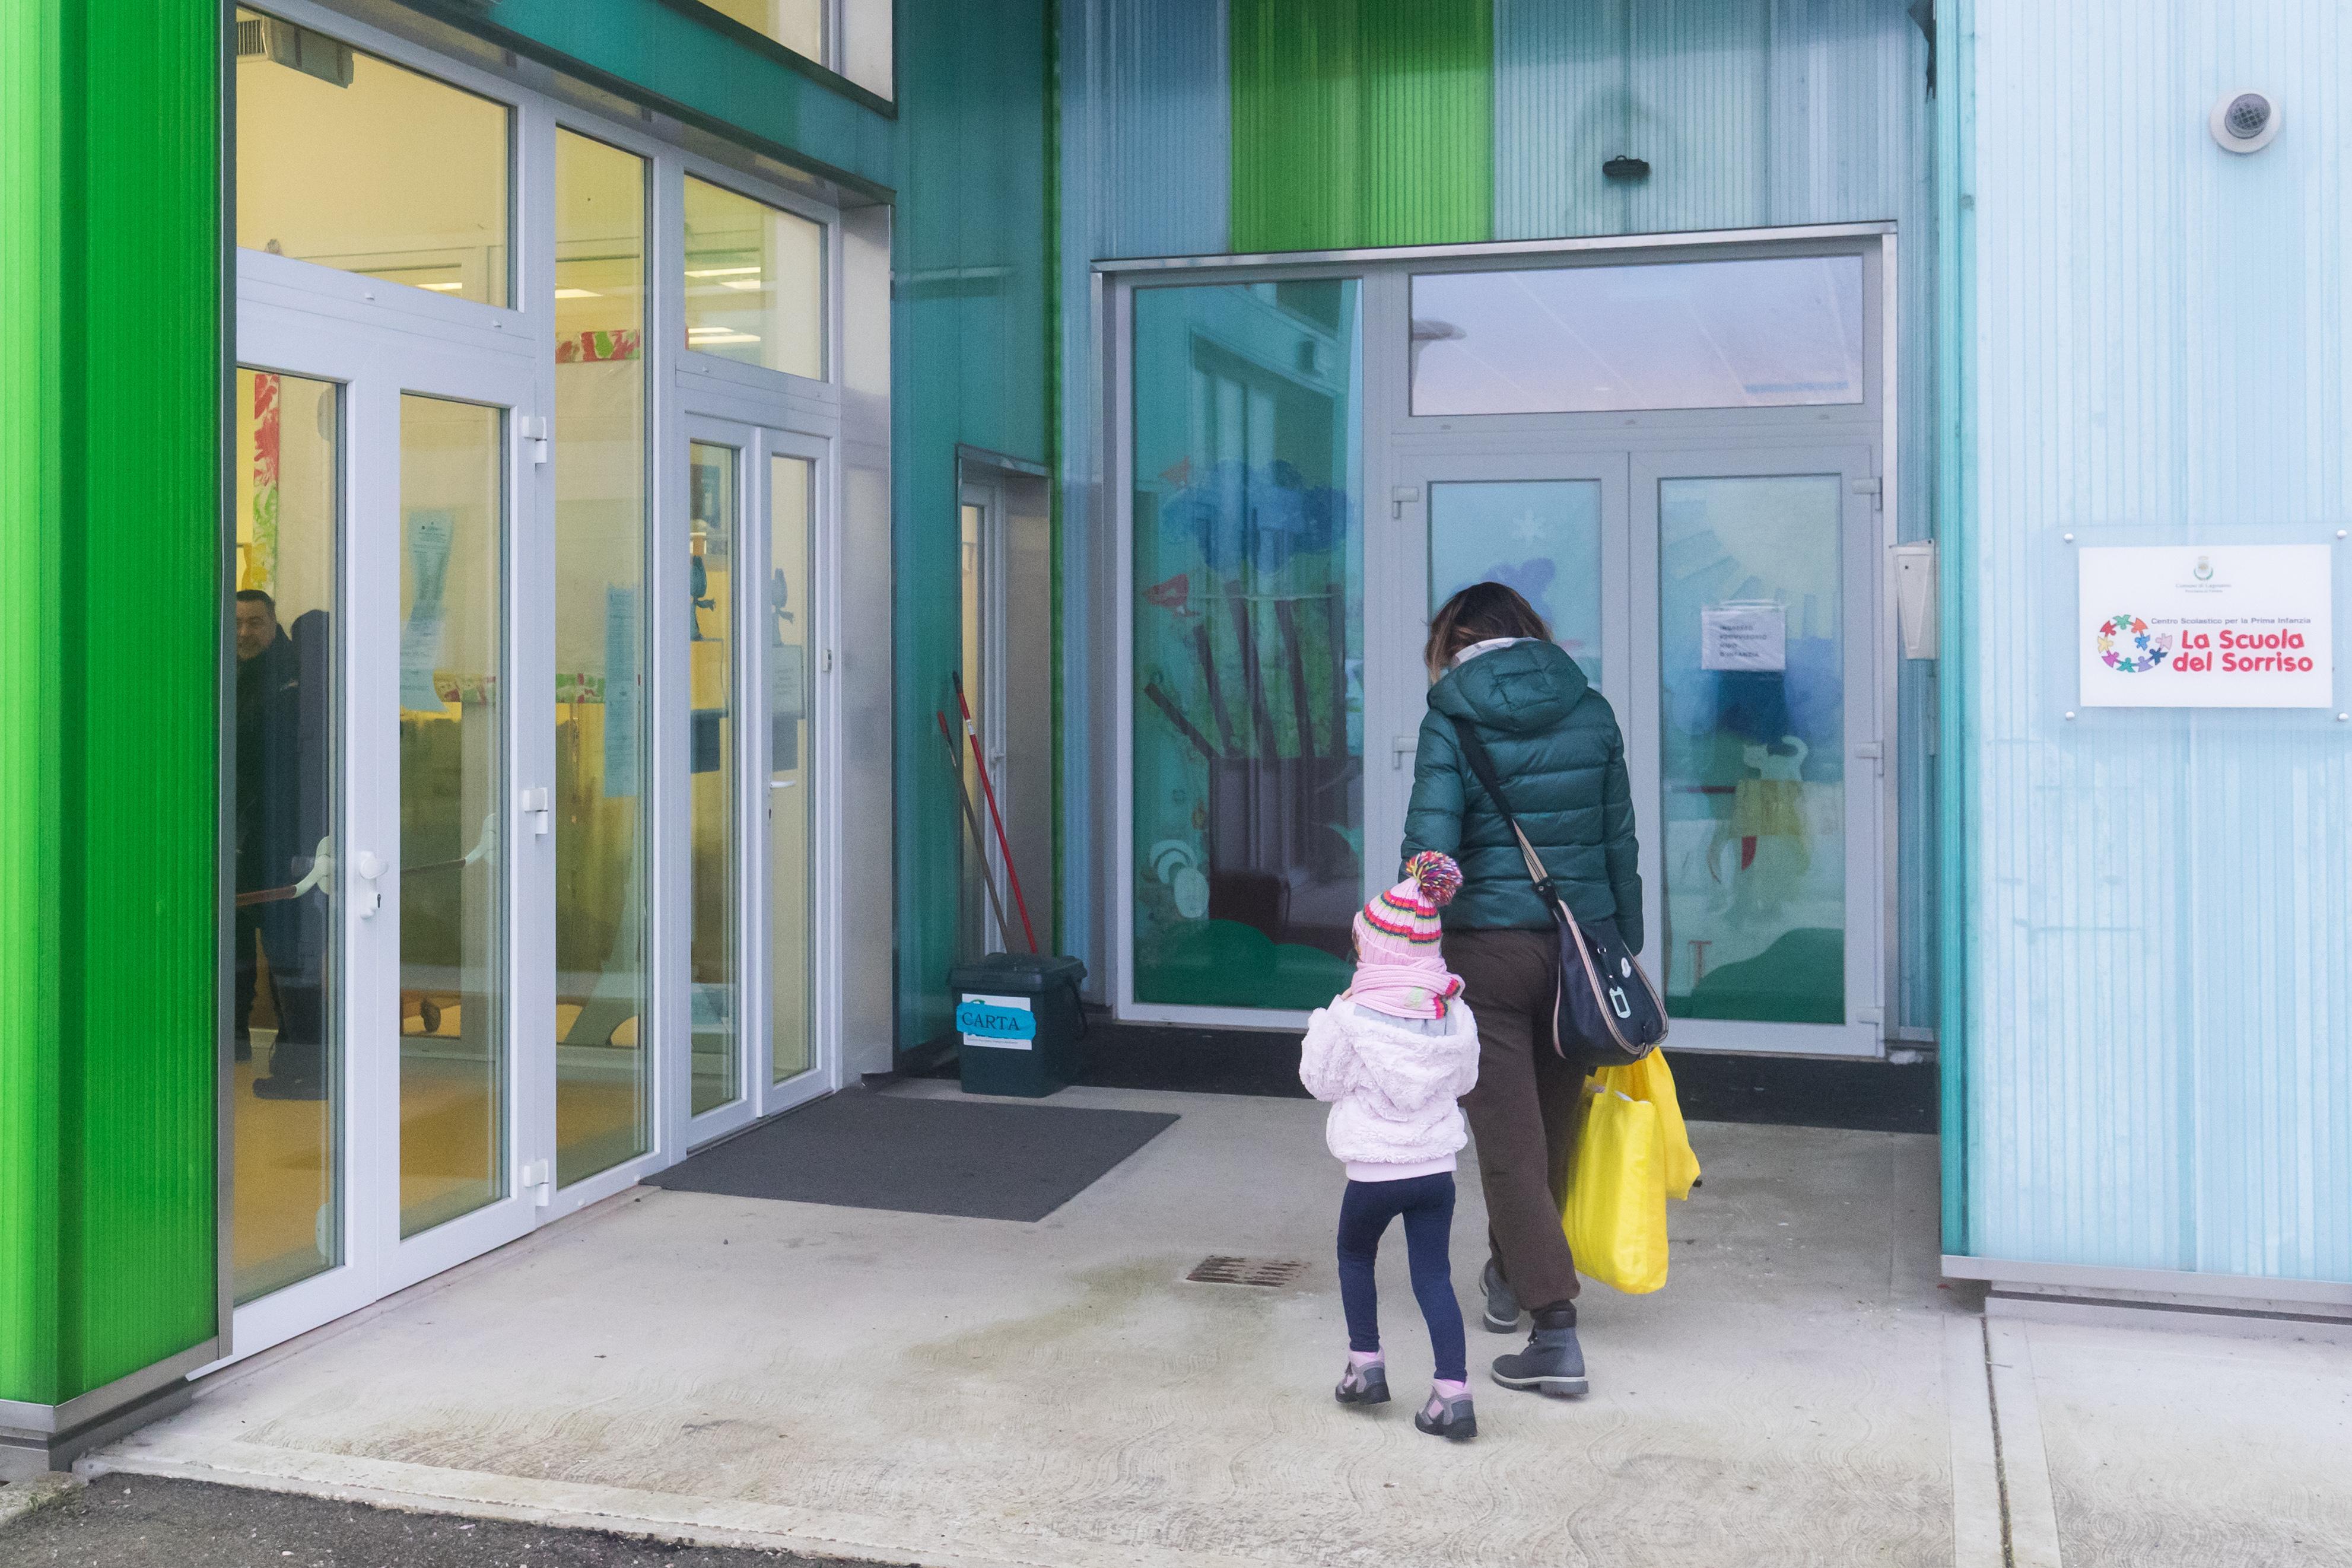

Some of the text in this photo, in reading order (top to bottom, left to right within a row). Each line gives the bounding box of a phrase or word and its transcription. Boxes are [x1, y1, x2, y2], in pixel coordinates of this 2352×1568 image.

[2182, 628, 2305, 649] La Scuola
[2173, 651, 2313, 672] del Sorriso
[962, 1012, 1020, 1031] CARTA
